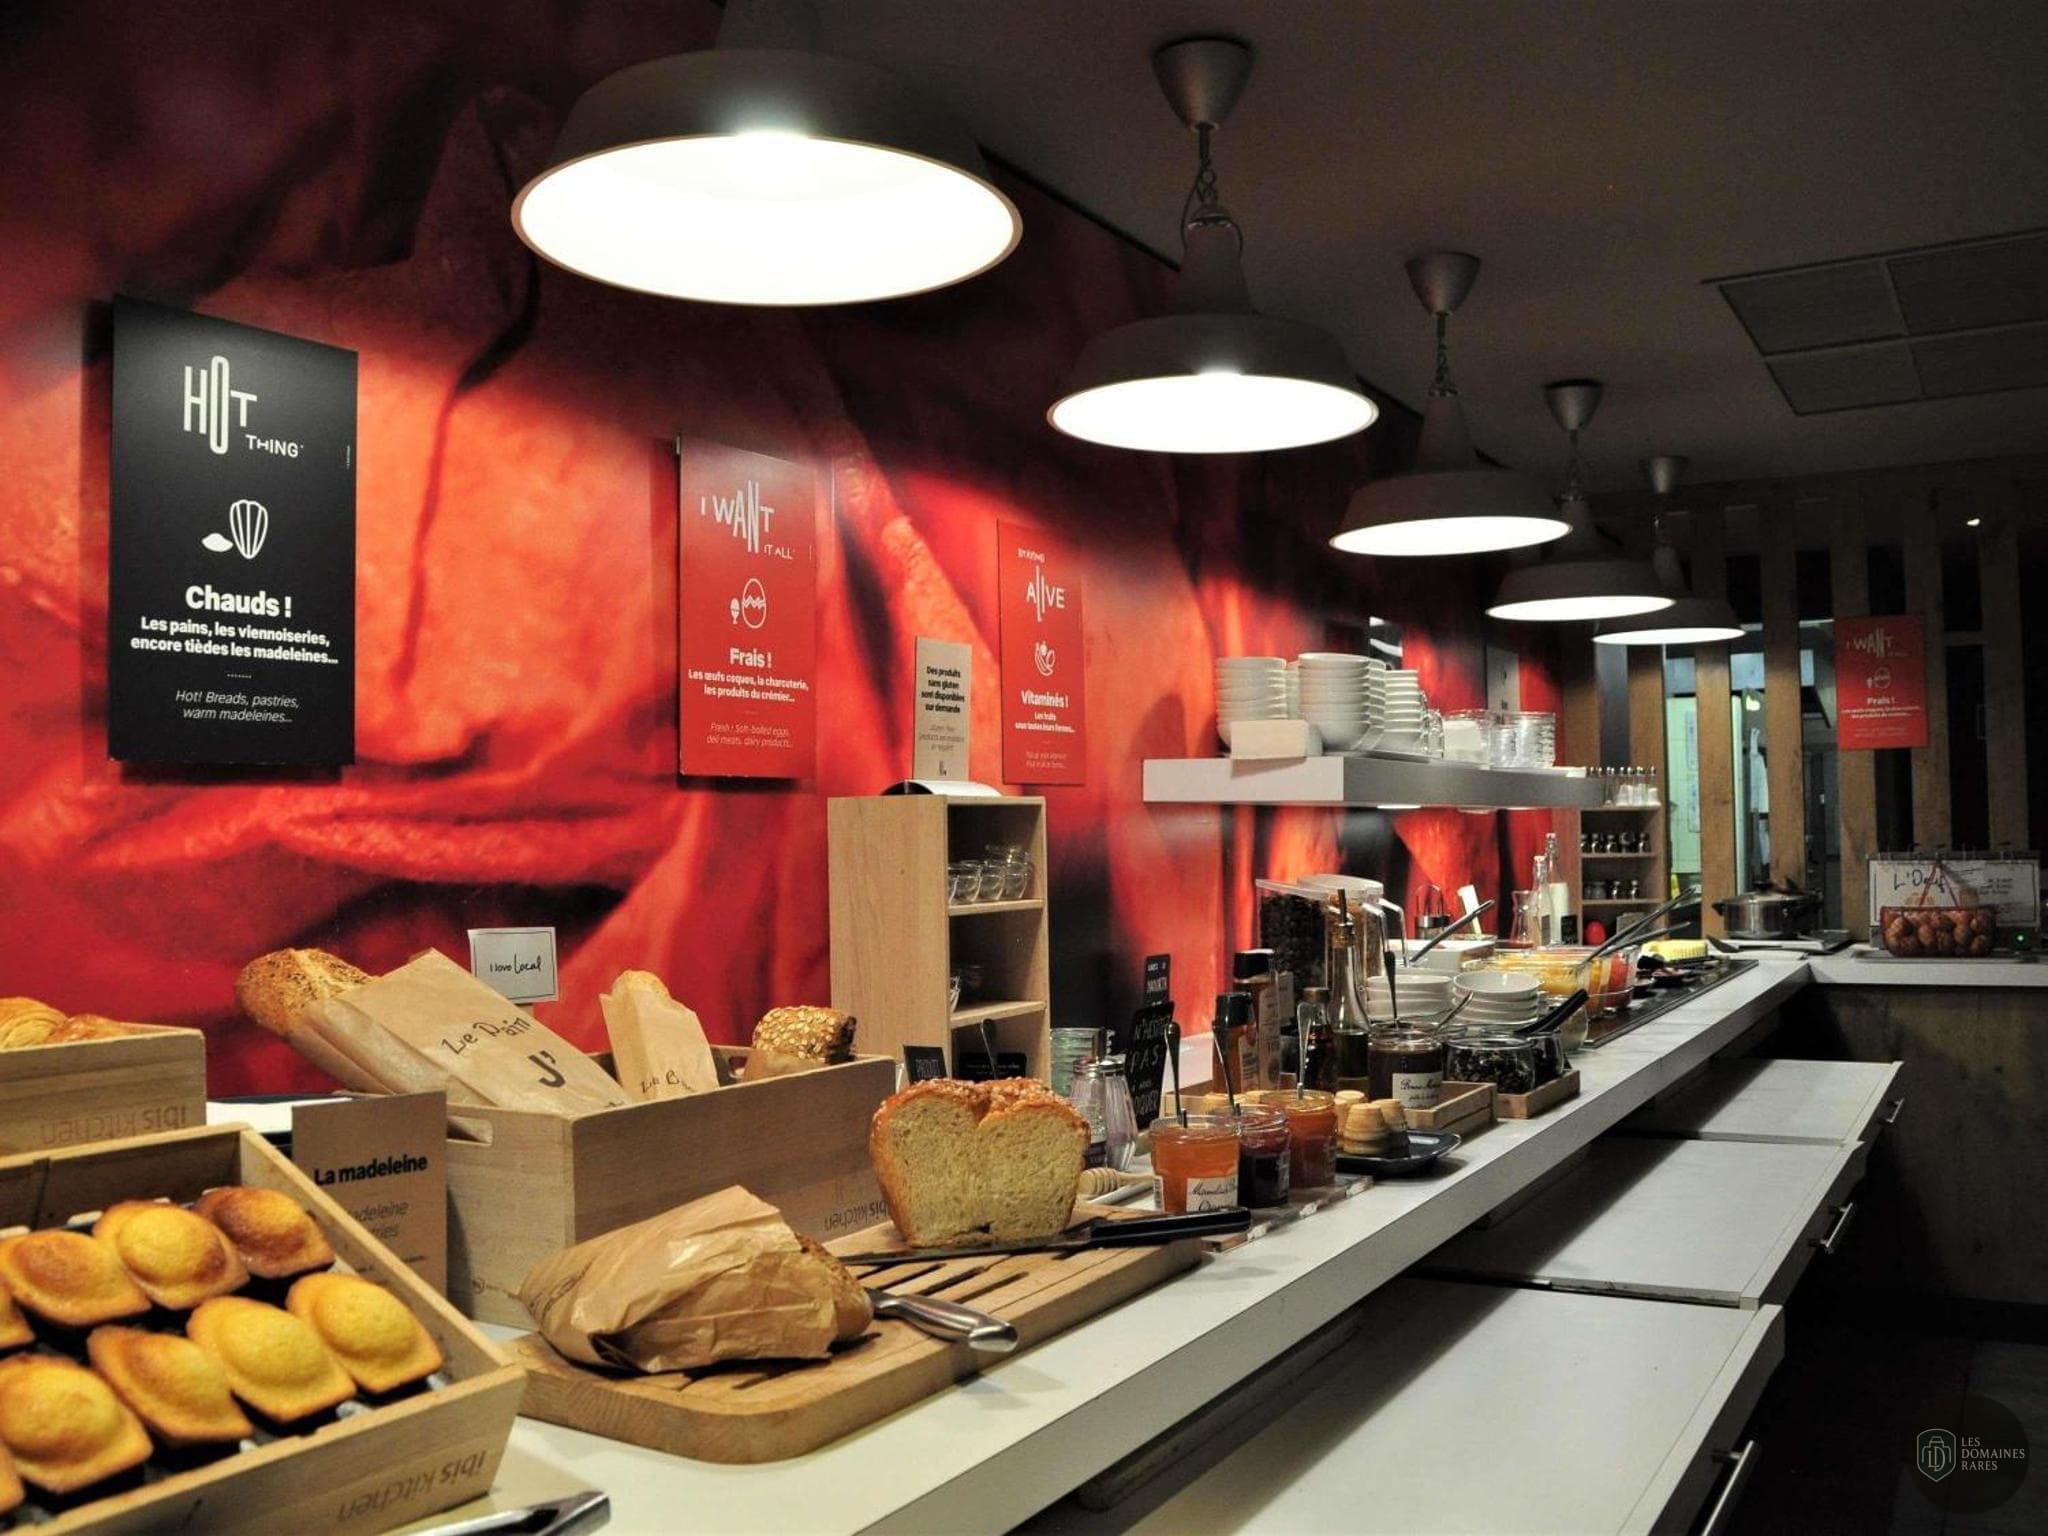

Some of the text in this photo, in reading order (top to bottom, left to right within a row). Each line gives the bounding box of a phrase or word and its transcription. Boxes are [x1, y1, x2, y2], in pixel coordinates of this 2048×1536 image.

[184, 355, 257, 454] HOT
[245, 434, 300, 459] THING
[712, 479, 774, 553] WANT
[141, 616, 331, 648] Les pains, les viennoiseries,
[130, 636, 182, 653] encore
[184, 638, 229, 656] tièdes
[230, 642, 252, 658] les
[688, 668, 703, 680] Les
[182, 708, 217, 720] warm
[205, 691, 250, 707] Breads,
[251, 694, 301, 710] pastries,
[314, 1153, 428, 1186] La madeleine
[440, 1450, 487, 1484] ibis
